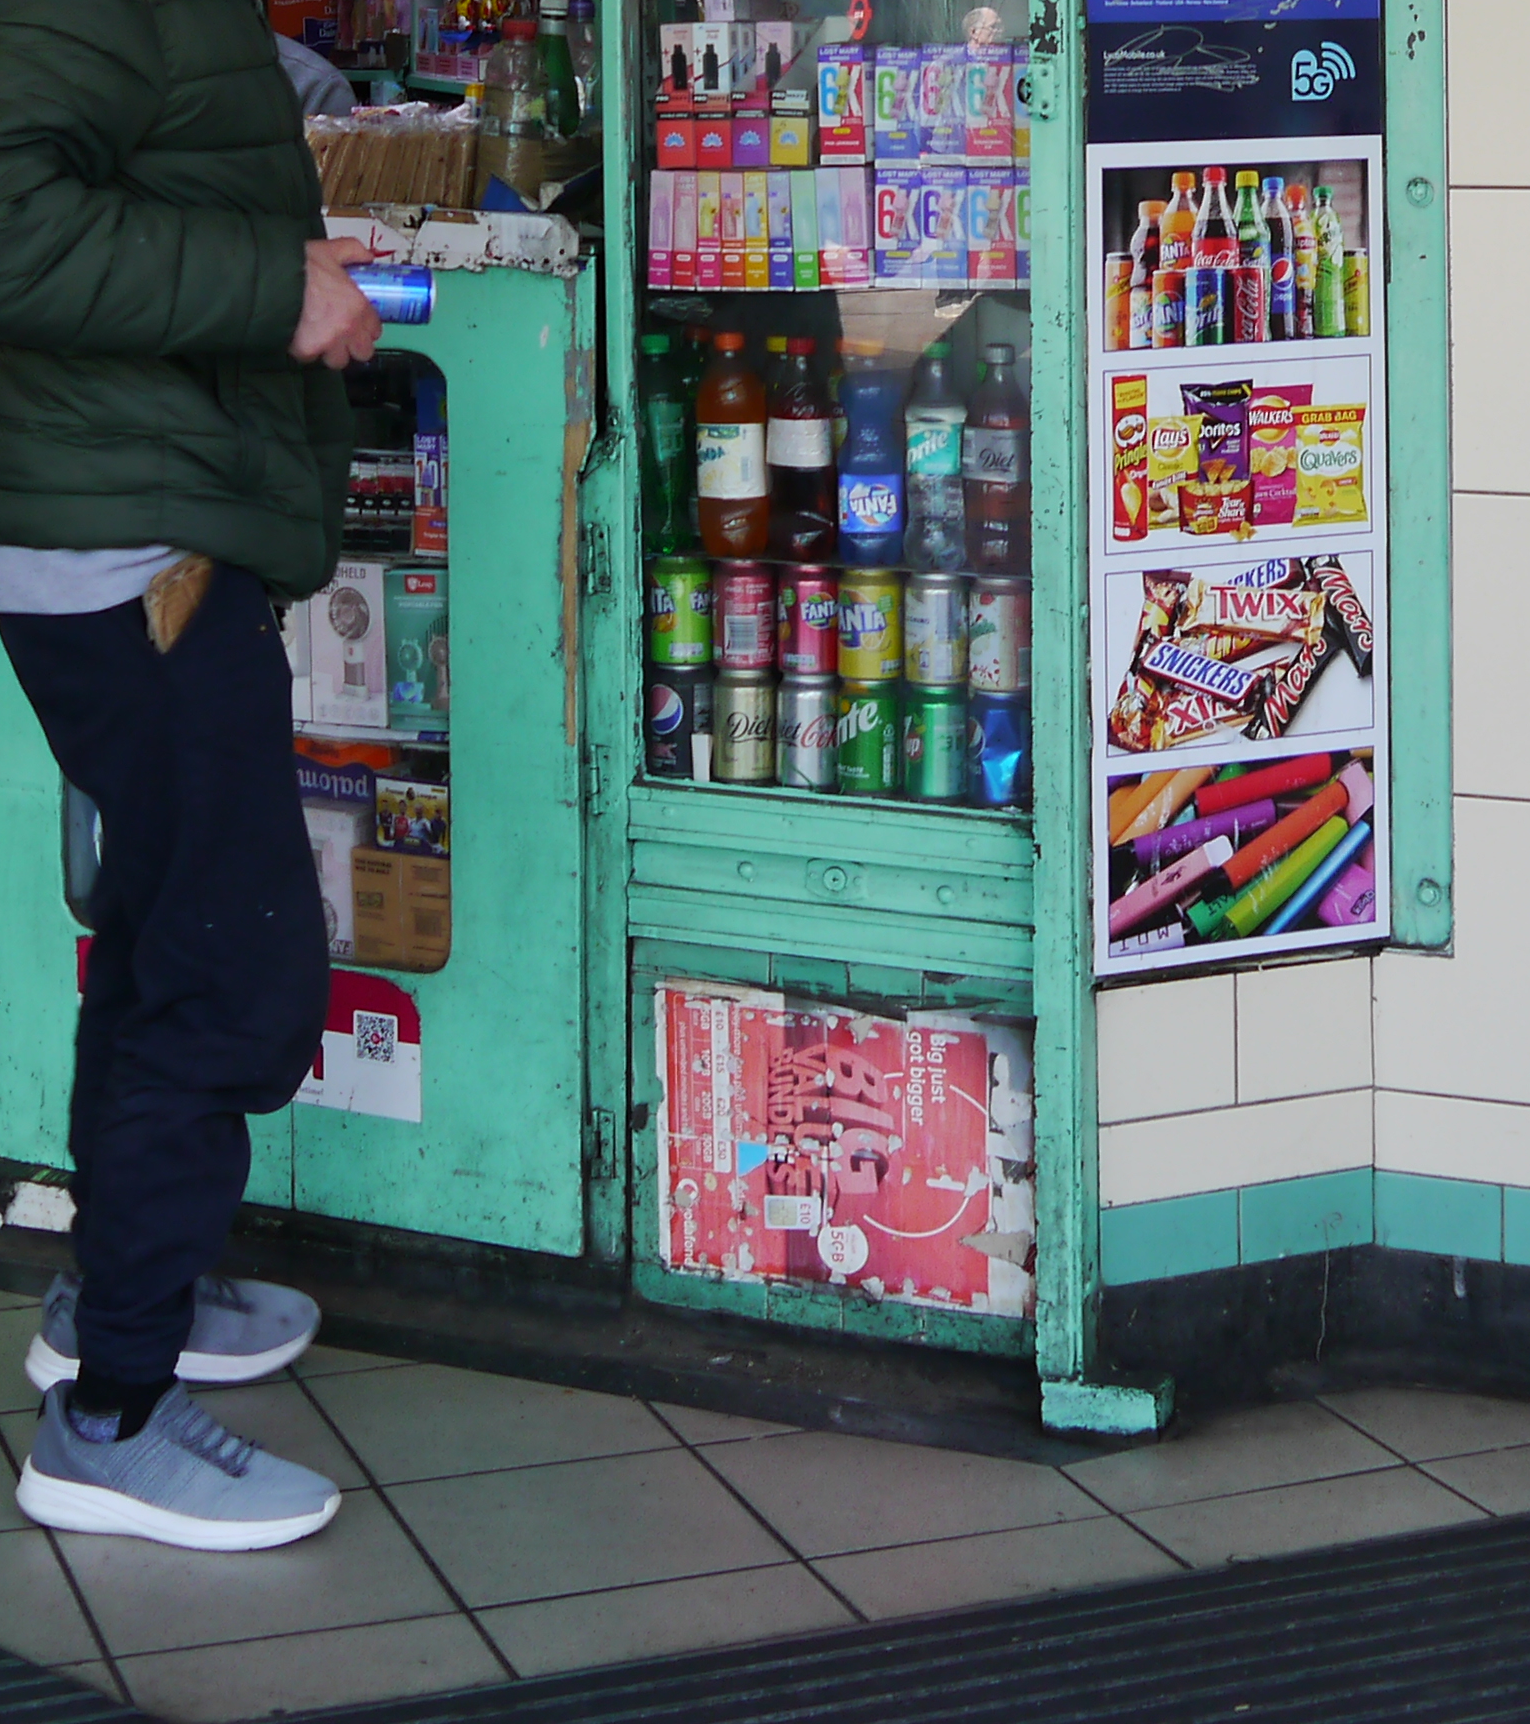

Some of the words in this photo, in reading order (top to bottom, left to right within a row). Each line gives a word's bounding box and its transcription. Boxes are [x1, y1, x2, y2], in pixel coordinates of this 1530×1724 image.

[819, 46, 840, 56] LOST
[842, 46, 864, 55] MARY
[1293, 60, 1333, 98] 5G
[1249, 410, 1293, 426] WALKERS
[1301, 413, 1332, 424] GRAB
[1335, 411, 1357, 423] BAG
[907, 431, 949, 471] prite
[849, 490, 897, 517] FANTA
[838, 603, 886, 632] ANTA
[1314, 567, 1373, 651] Mars
[1150, 644, 1253, 697] SNICKERS
[1264, 636, 1326, 738] Mars
[800, 713, 838, 749] Cok
[715, 1011, 725, 1031] £10
[906, 1031, 924, 1063] got
[928, 1033, 947, 1064] Big
[715, 1053, 725, 1074] £15
[906, 1066, 925, 1126] bigger
[929, 1066, 947, 1104] just
[716, 1097, 726, 1117] £20
[825, 1043, 896, 1195] BIG
[799, 1202, 811, 1225] £10
[830, 1229, 845, 1264] 5GB
